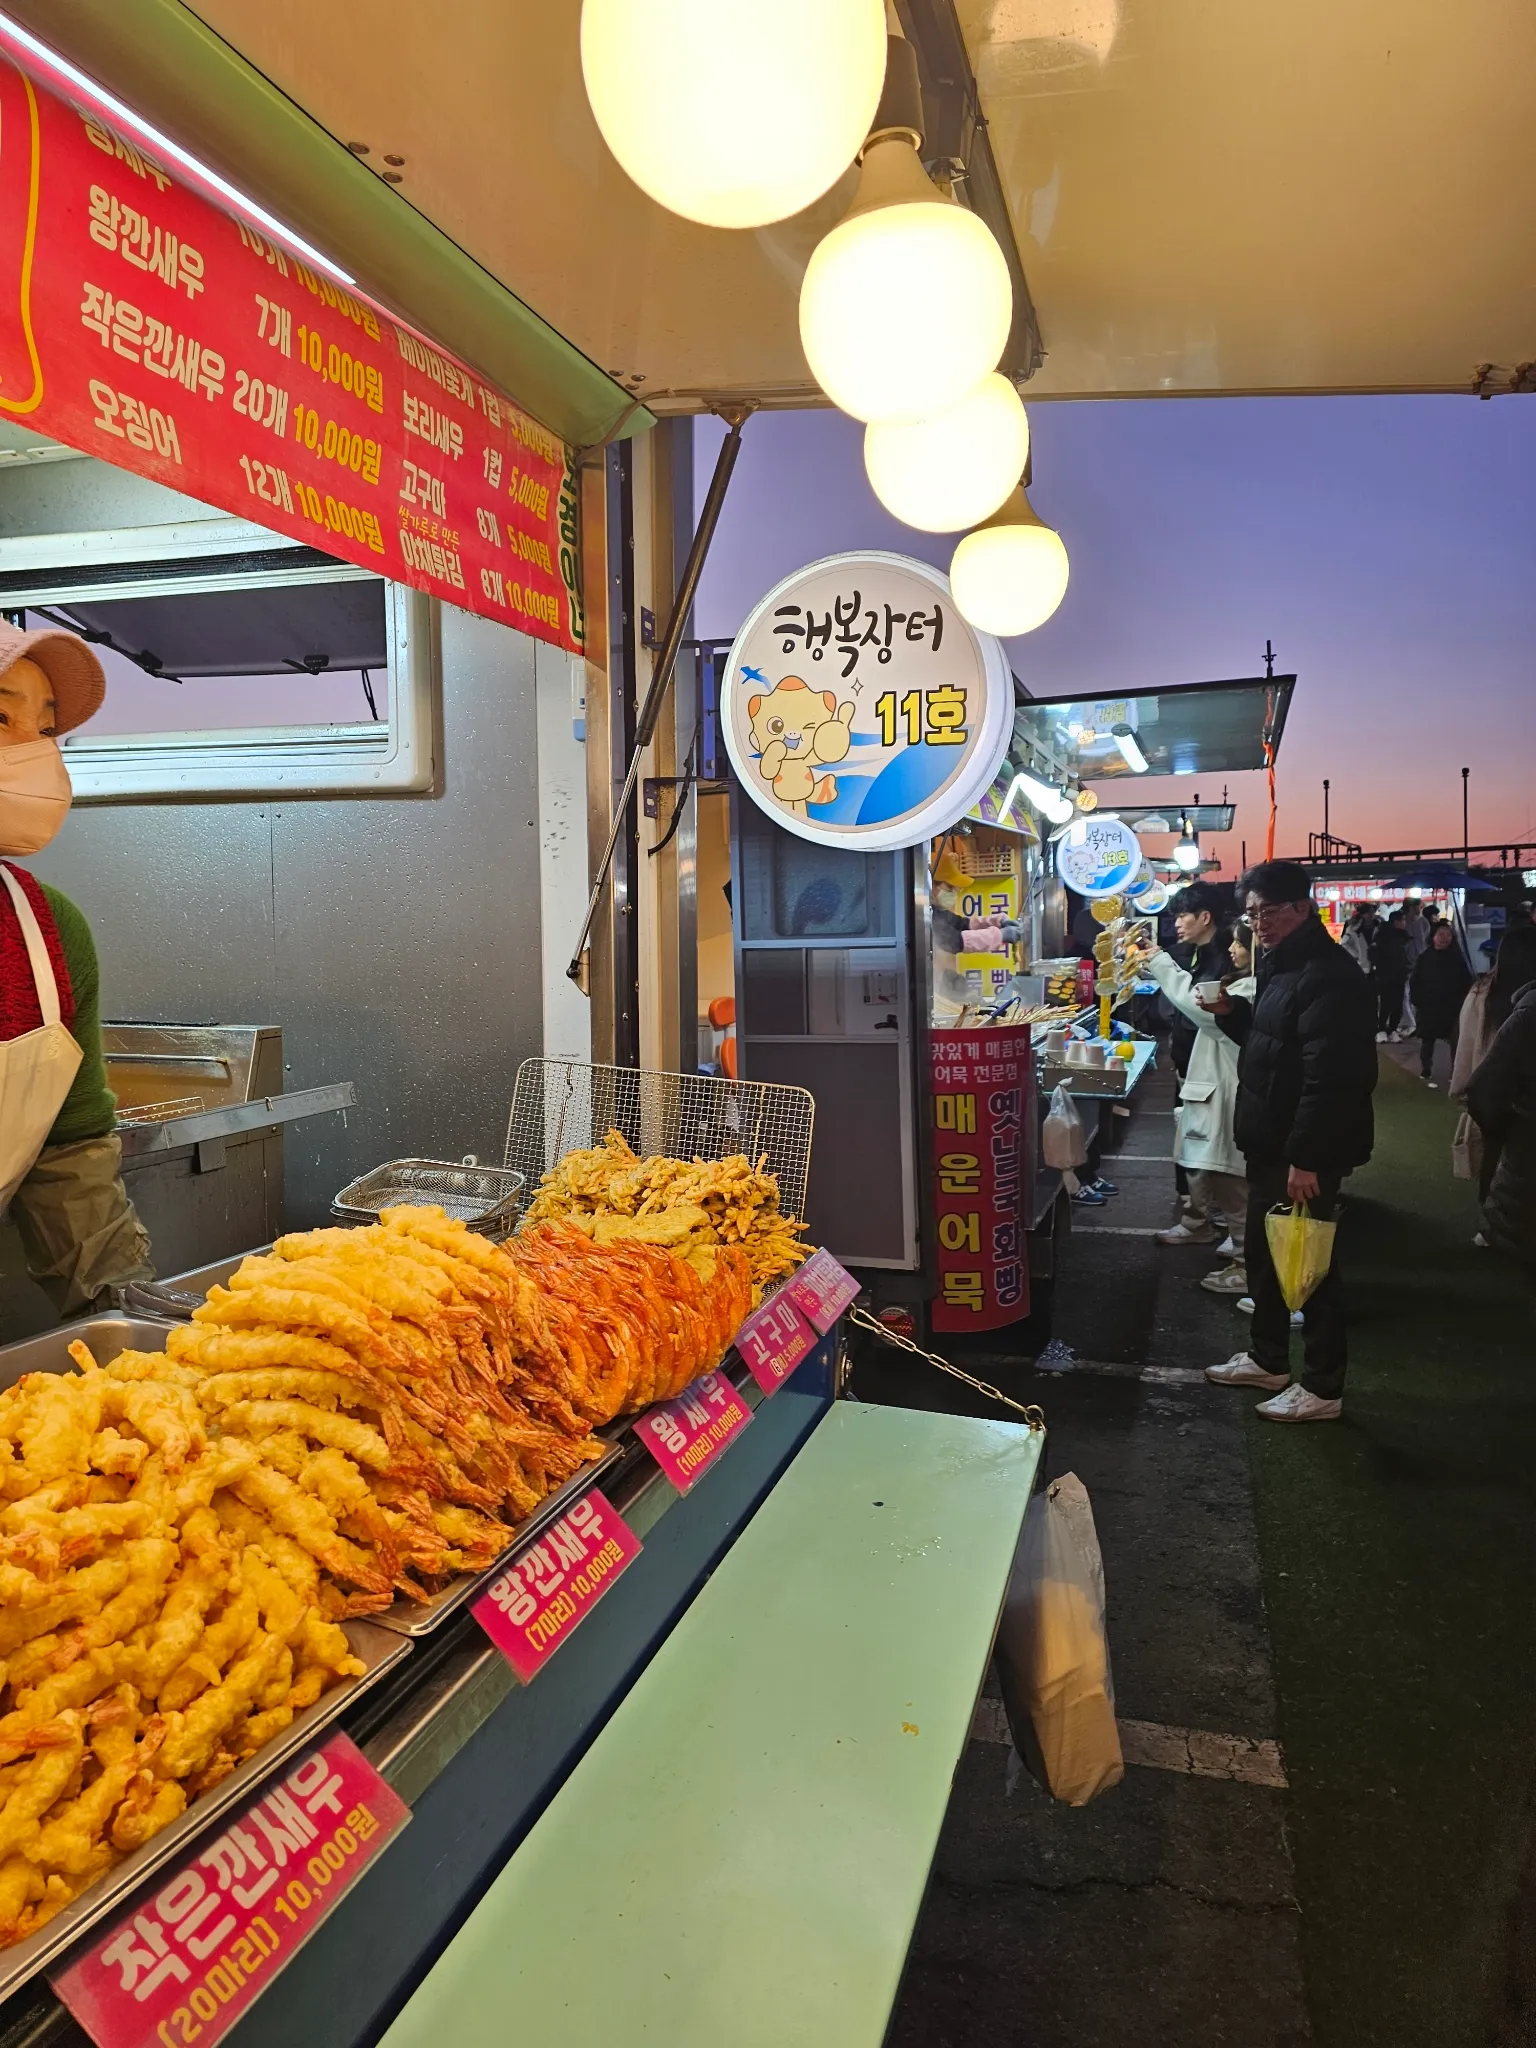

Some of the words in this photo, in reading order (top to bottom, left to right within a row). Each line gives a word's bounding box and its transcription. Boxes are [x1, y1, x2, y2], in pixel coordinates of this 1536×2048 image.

[89, 185, 204, 299] 왕깐새우
[255, 294, 291, 358] 7개
[298, 325, 383, 414] 10,000원
[81, 282, 225, 402] 작은깐새우
[233, 371, 288, 439] 20개
[294, 403, 382, 485] 10,000원
[479, 386, 501, 428] 1컵
[89, 379, 182, 465] 오징어
[239, 454, 294, 515] 12개
[295, 481, 385, 555] 10,000원
[403, 389, 464, 461] 보리새우
[483, 446, 502, 489] 1컵
[508, 466, 549, 521] 5,000원
[399, 459, 446, 519] 고구마
[477, 507, 501, 548] 8개
[507, 524, 553, 576] 5,000원
[399, 505, 438, 540] 쌀가루로
[441, 525, 460, 551] 만든
[400, 529, 465, 589] 야채튀김
[480, 568, 505, 607] 8개
[506, 580, 560, 629] 10,000원
[773, 590, 943, 677] 행복장터
[875, 684, 967, 747] 11호
[1102, 850, 1129, 866] 13호
[934, 1065, 968, 1084] 어묵
[973, 1063, 1018, 1084] 전문점
[985, 1038, 1026, 1059] 매콤한
[803, 1254, 846, 1297] 야채튀김
[743, 1300, 800, 1365] 고구마
[784, 1333, 806, 1362] 5,000원
[676, 1432, 715, 1476] (10마리)
[708, 1402, 744, 1442] 10,000원
[487, 1498, 604, 1626] 왕깐새우
[525, 1590, 577, 1652] (7마리)
[570, 1537, 625, 1600] 10,000원
[101, 1753, 344, 2002] 작은깐새우
[157, 1916, 281, 2048] (20마리)
[274, 1803, 380, 1923] 10,000원
